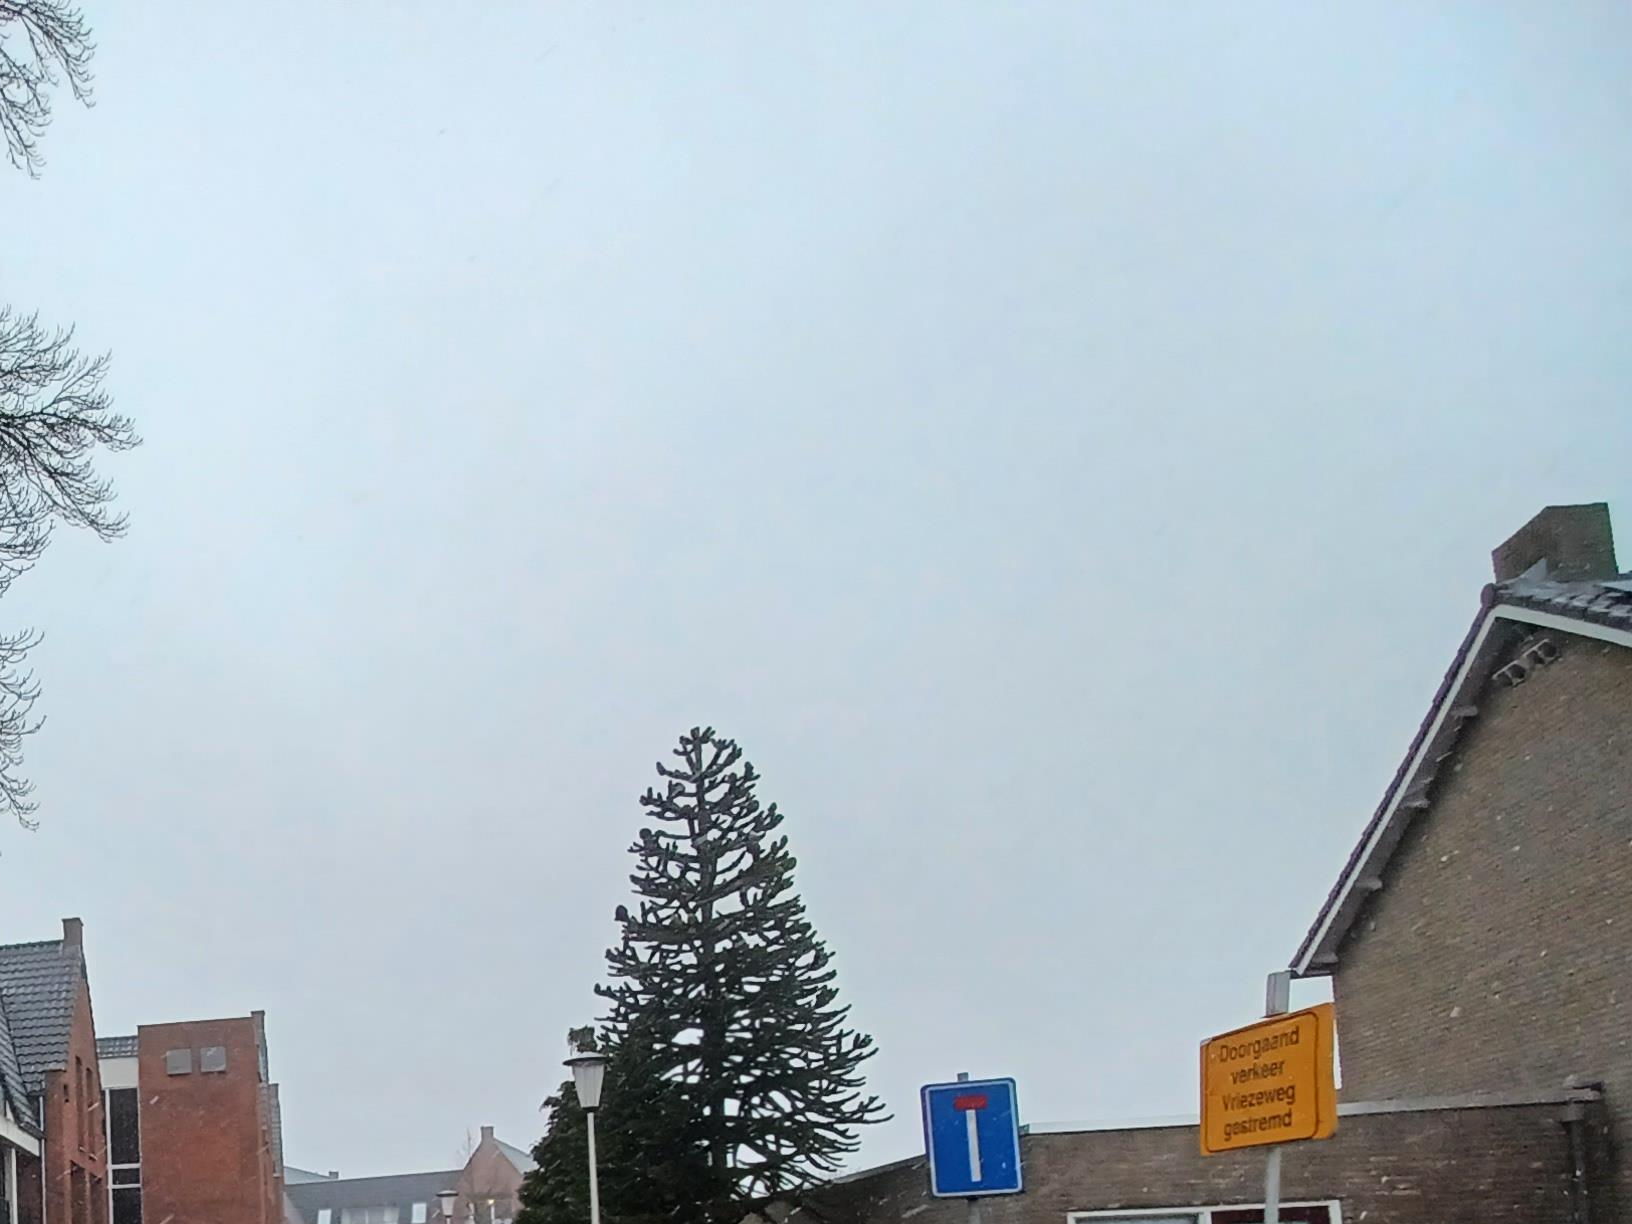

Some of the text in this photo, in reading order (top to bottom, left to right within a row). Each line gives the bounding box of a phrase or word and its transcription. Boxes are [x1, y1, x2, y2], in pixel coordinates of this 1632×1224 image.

[1219, 1025, 1300, 1063] Doorgaand
[1230, 1060, 1285, 1085] verkeer
[1222, 1085, 1296, 1112] Vriezeweg
[1223, 1108, 1293, 1142] gestremd
